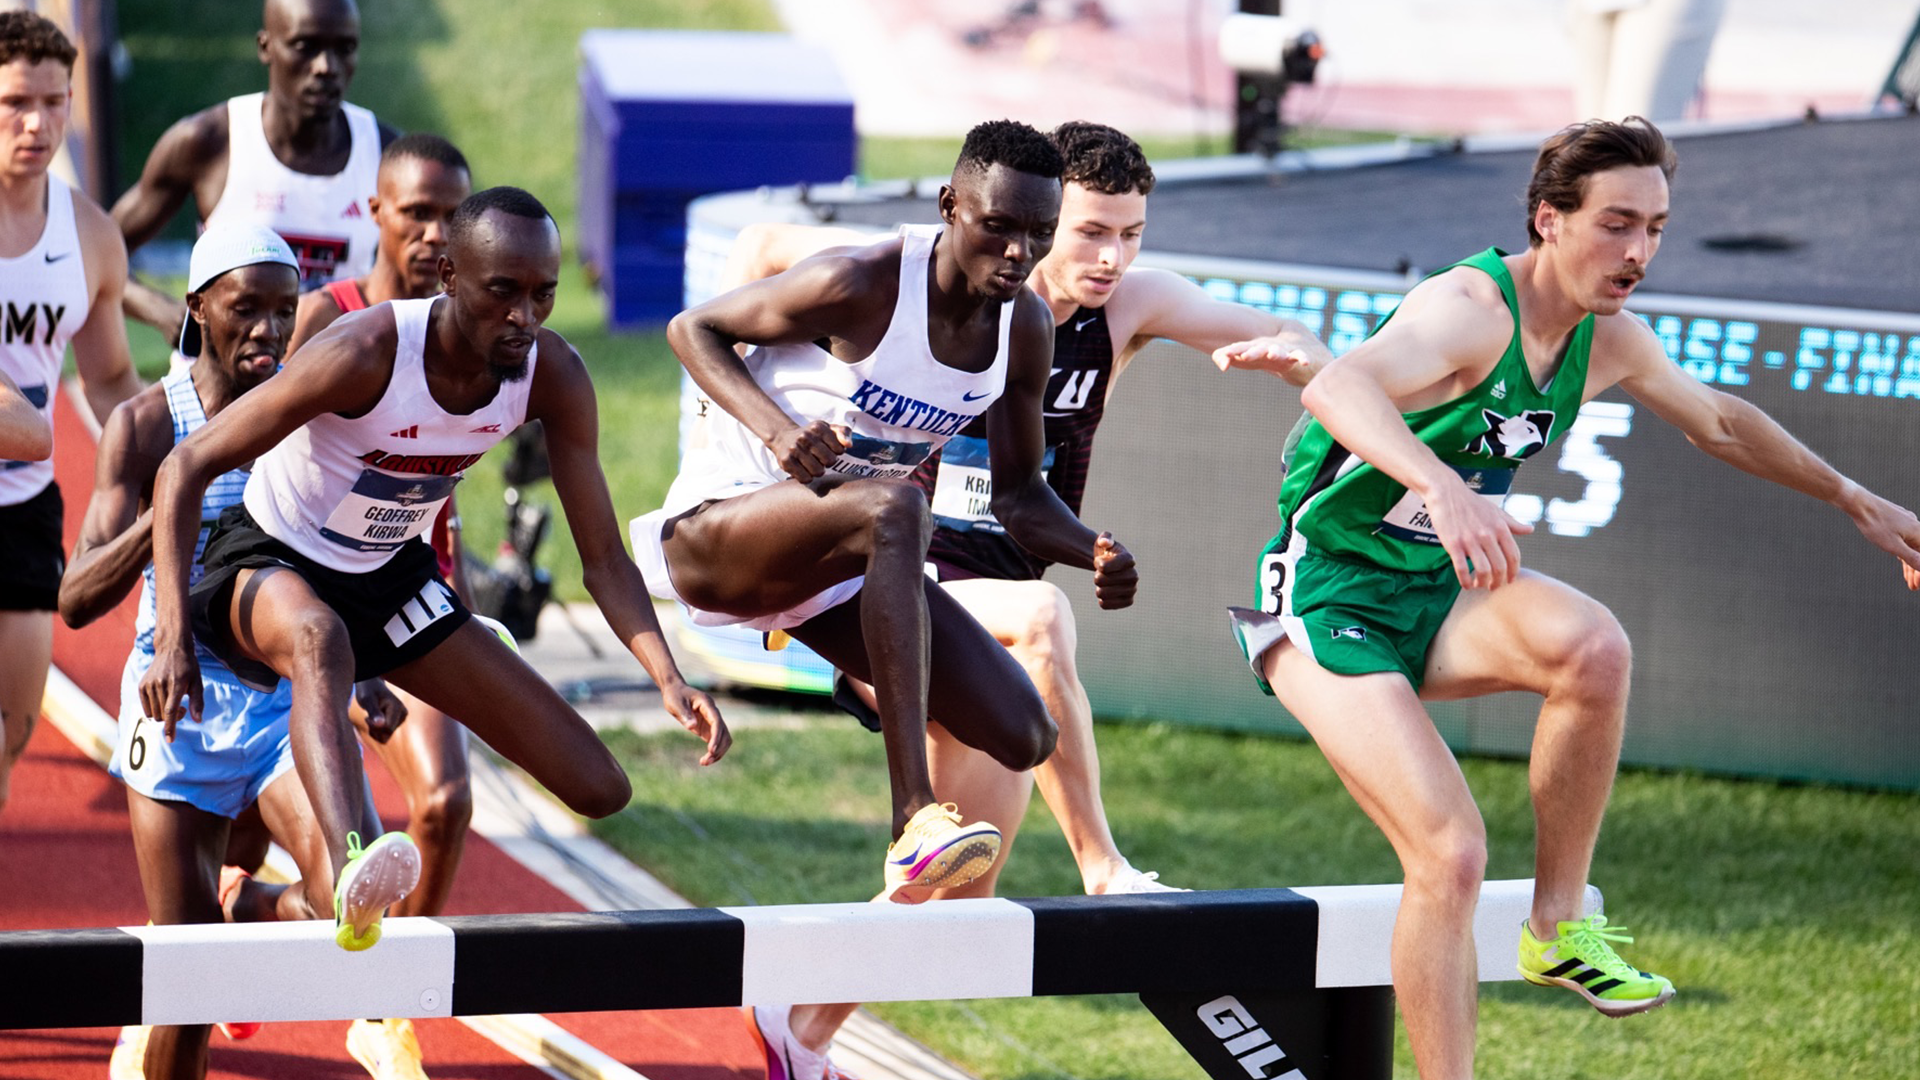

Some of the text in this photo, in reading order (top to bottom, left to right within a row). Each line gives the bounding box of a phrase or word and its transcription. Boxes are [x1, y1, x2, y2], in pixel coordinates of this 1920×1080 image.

[0, 302, 66, 345] MY
[1050, 368, 1099, 410] U
[831, 457, 867, 477] LLINS
[363, 523, 409, 539] KIRWA
[364, 506, 431, 523] GEOFFREY
[1266, 561, 1286, 616] 3
[129, 717, 146, 771] 6
[1196, 994, 1309, 1080] GIL
